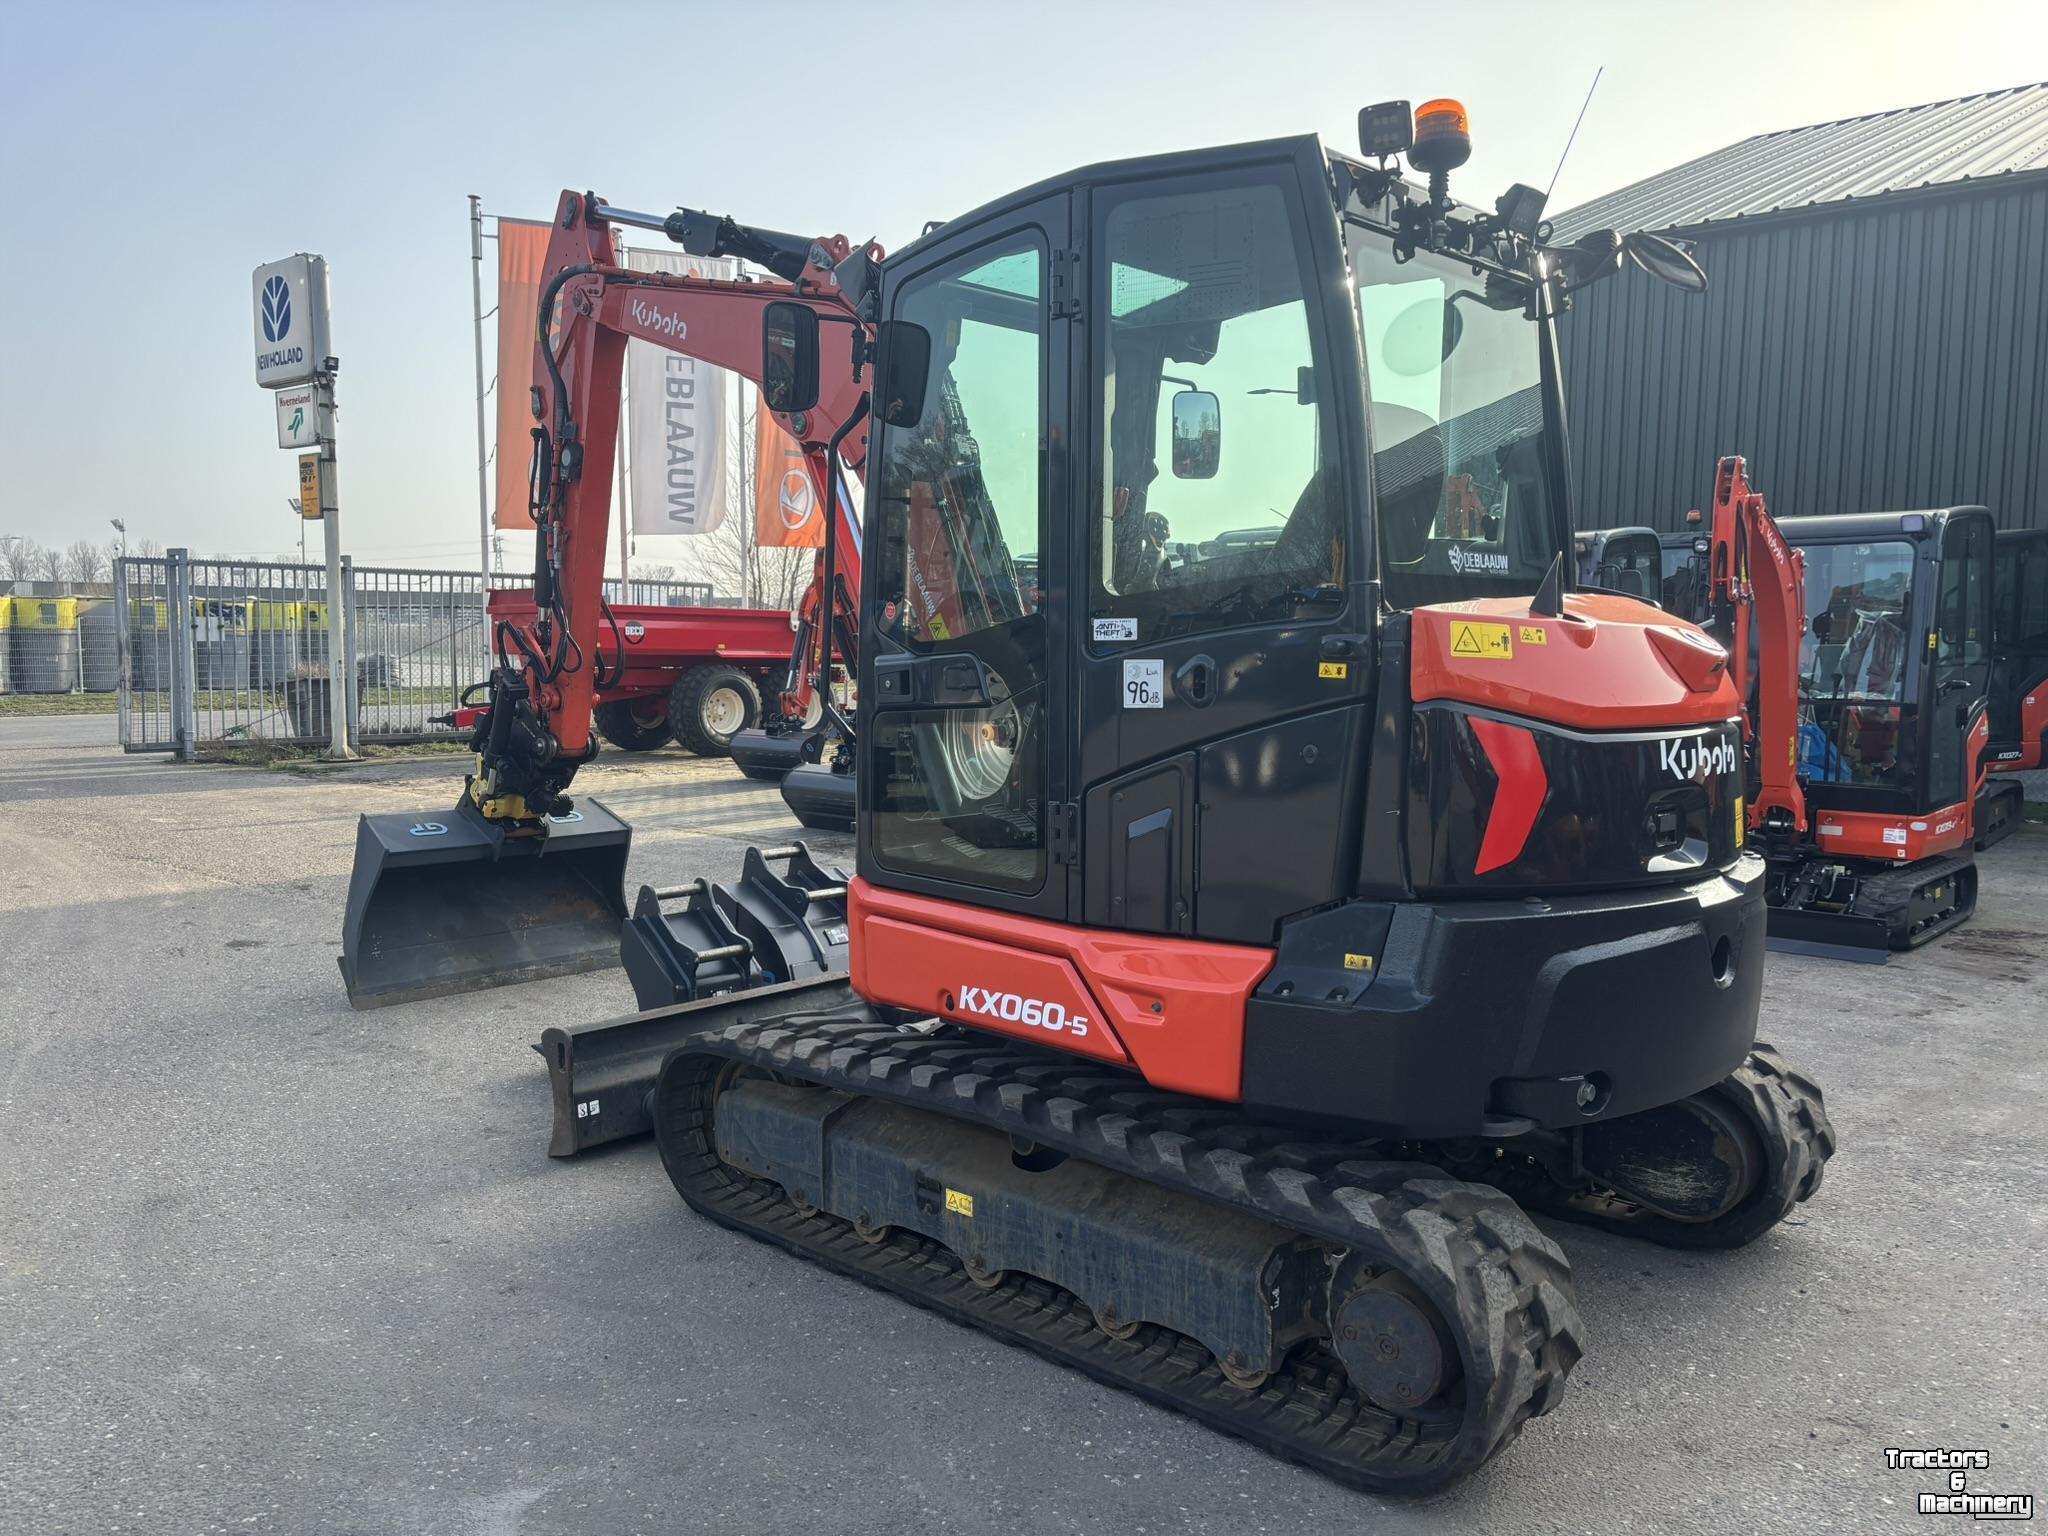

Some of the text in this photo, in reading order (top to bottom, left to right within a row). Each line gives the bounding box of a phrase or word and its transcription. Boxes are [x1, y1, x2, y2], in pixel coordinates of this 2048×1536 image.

[632, 299, 687, 340] Kubota
[270, 347, 303, 368] HOLLAND
[665, 355, 695, 525] EBLAAUW
[1127, 681, 1160, 704] 96 dB
[1660, 734, 1736, 781] Kubota
[959, 985, 1089, 1037] KX060-5
